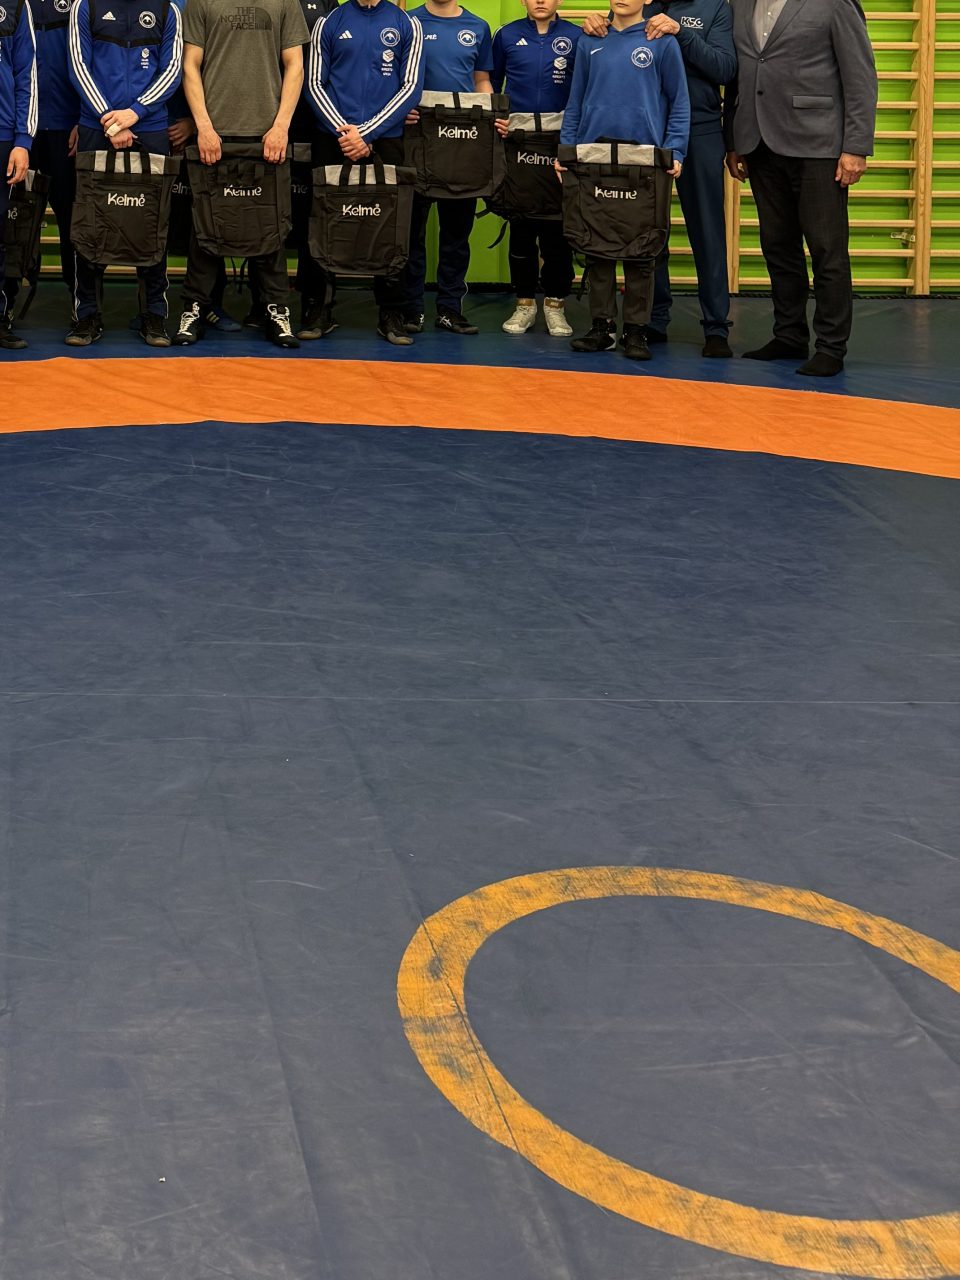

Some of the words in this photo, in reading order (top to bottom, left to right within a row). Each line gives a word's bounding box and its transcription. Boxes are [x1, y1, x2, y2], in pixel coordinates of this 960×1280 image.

[235, 6, 255, 15] THE
[220, 15, 255, 23] NORTH
[231, 22, 255, 30] FACE
[438, 125, 479, 140] Kelmė
[107, 192, 146, 207] Kelmė
[342, 203, 381, 217] Kelmė
